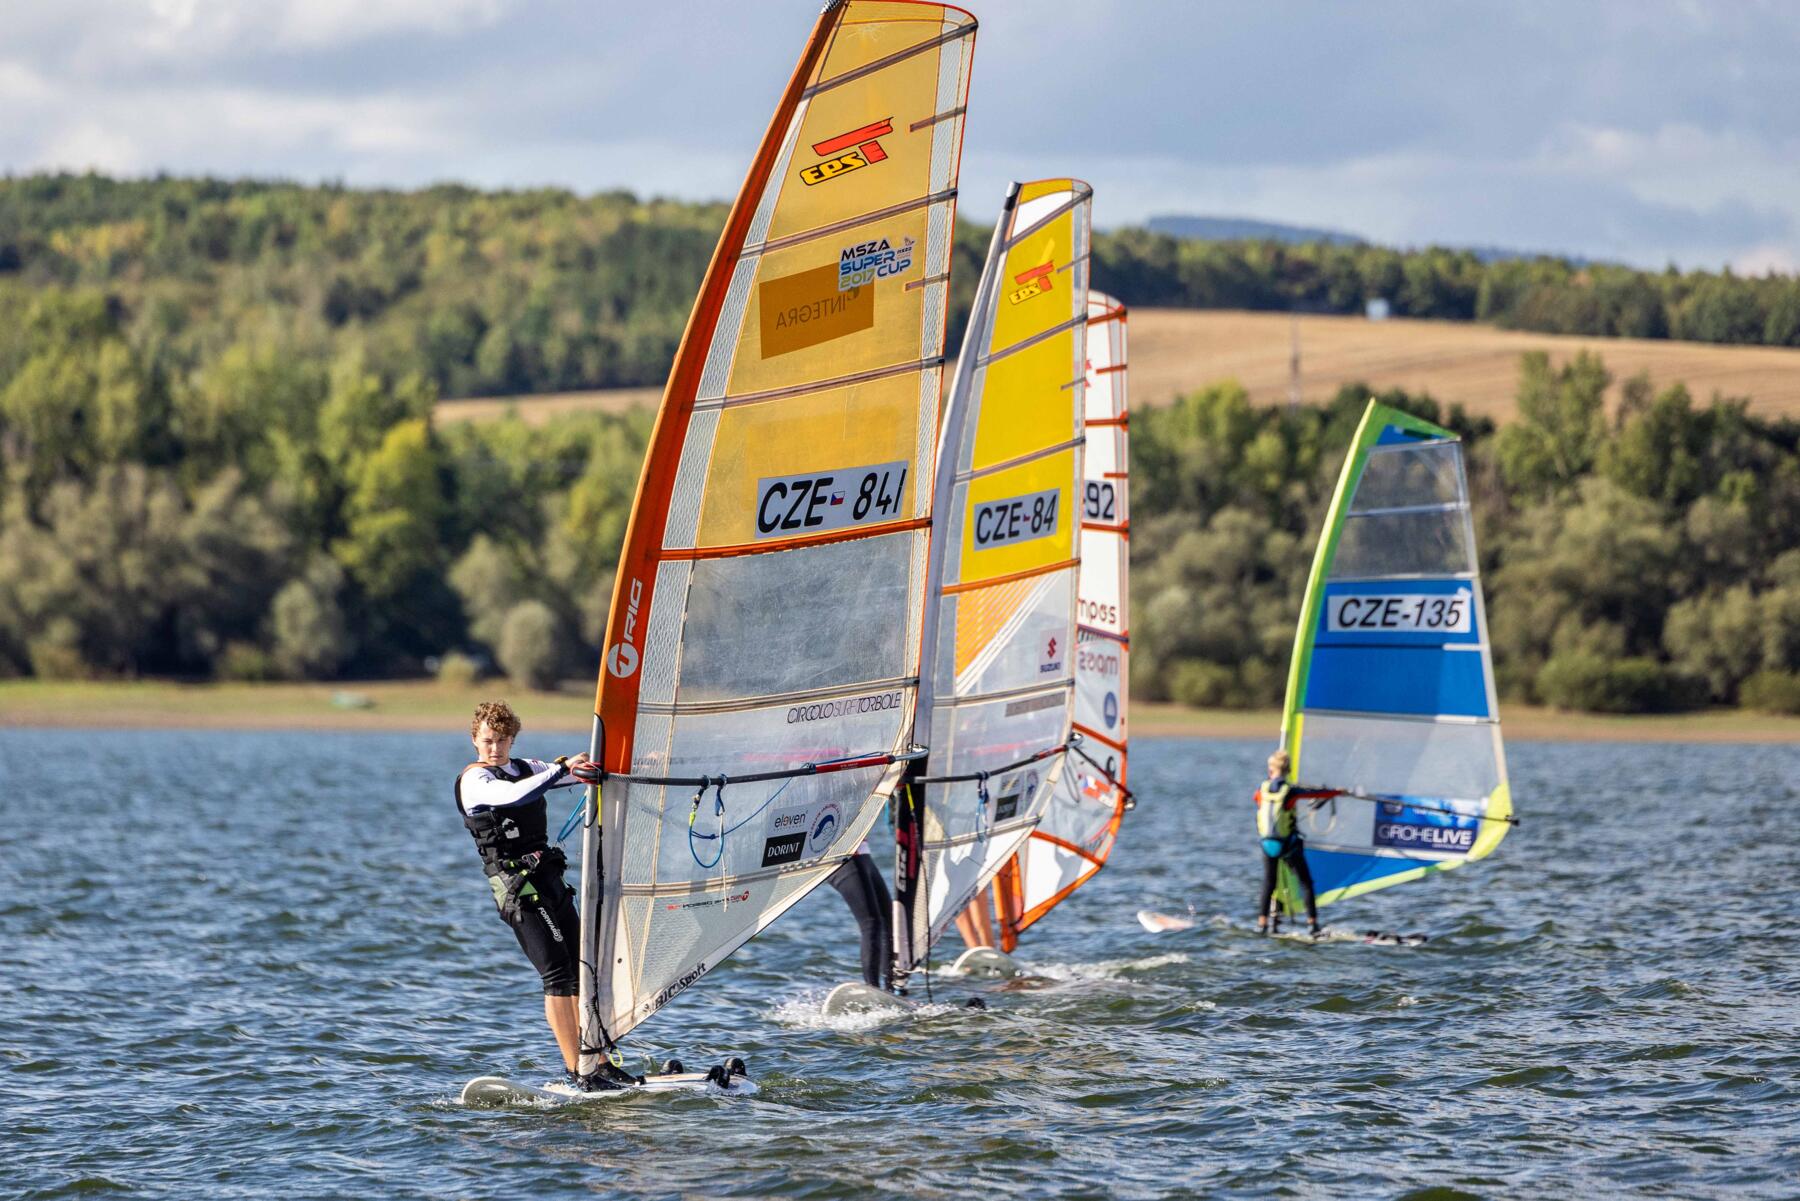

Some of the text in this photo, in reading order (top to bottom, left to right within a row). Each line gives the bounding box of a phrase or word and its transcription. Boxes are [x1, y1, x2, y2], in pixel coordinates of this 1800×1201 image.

[841, 239, 890, 262] MSZA
[840, 251, 895, 276] SUPER
[840, 259, 911, 289] 2017 CUP
[1339, 598, 1464, 628] CZE-135
[767, 842, 800, 858] DORINT
